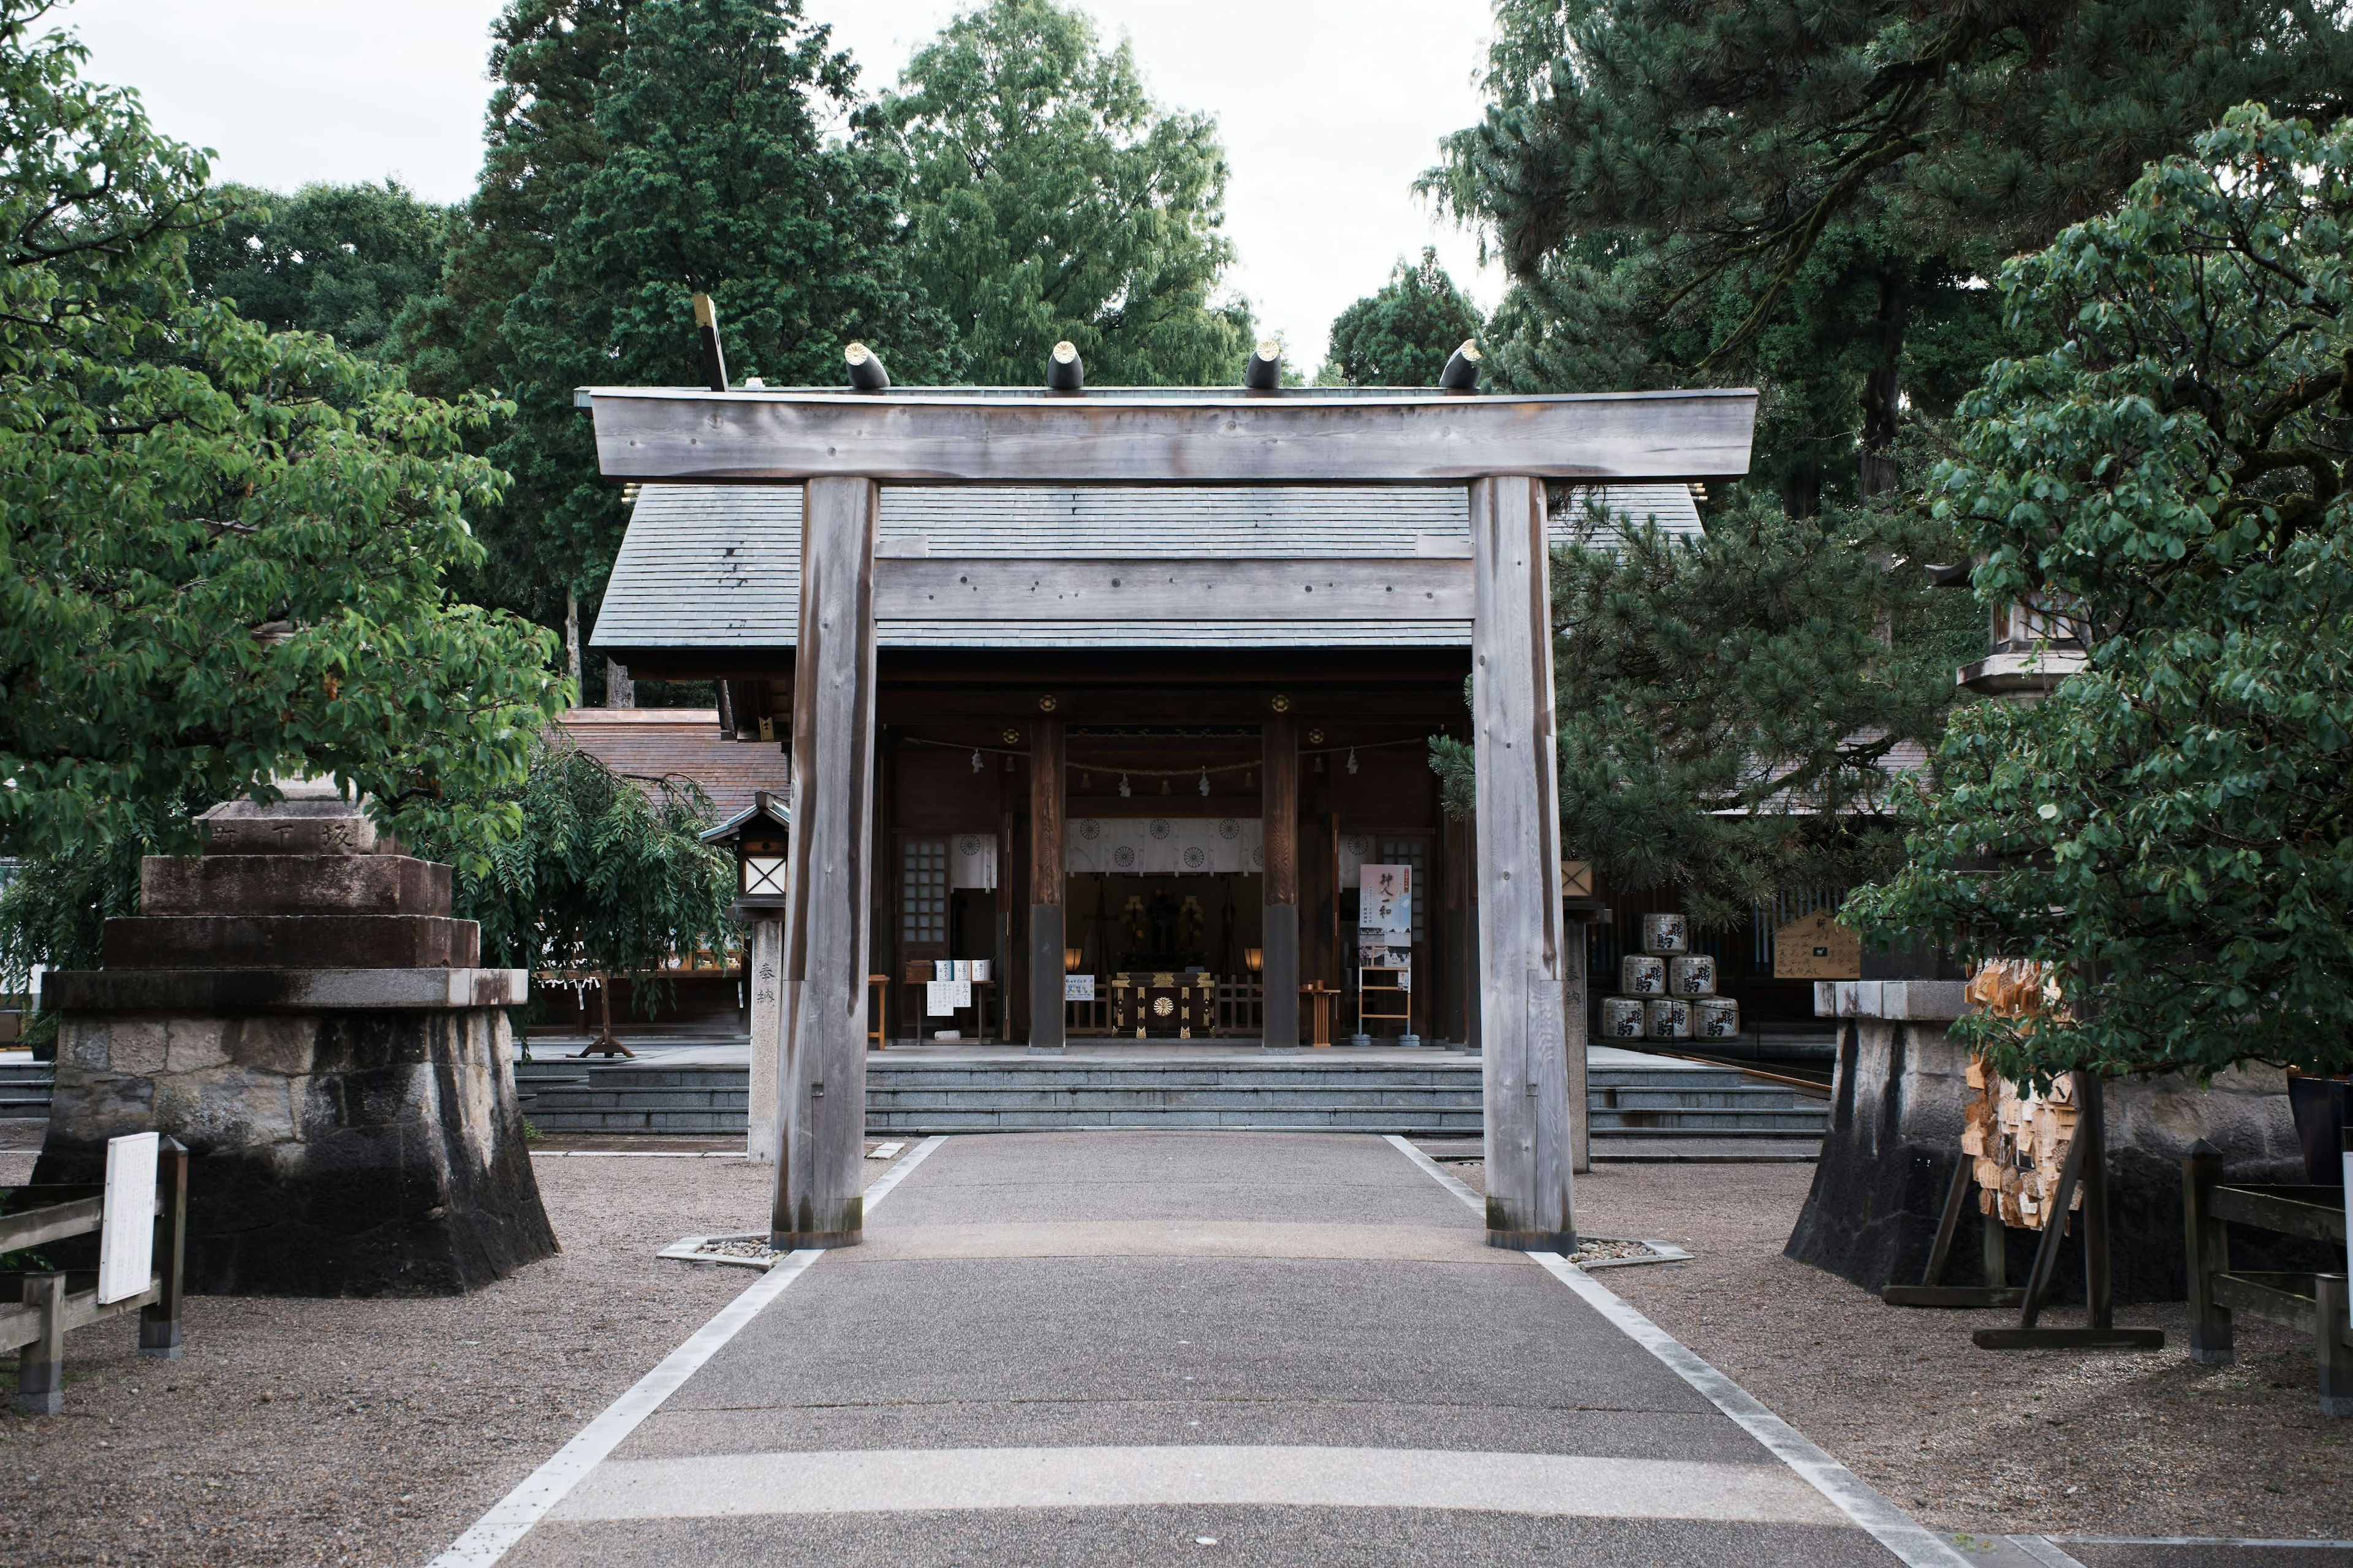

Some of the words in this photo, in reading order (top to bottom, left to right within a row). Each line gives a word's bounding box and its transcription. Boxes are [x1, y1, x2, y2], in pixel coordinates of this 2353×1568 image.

[1379, 873, 1393, 919] 神人一和
[757, 963, 775, 1004] 奉納
[1635, 965, 1662, 992] 勝駒
[1683, 965, 1710, 993] 勝駒
[1617, 1009, 1642, 1036] 勝駒
